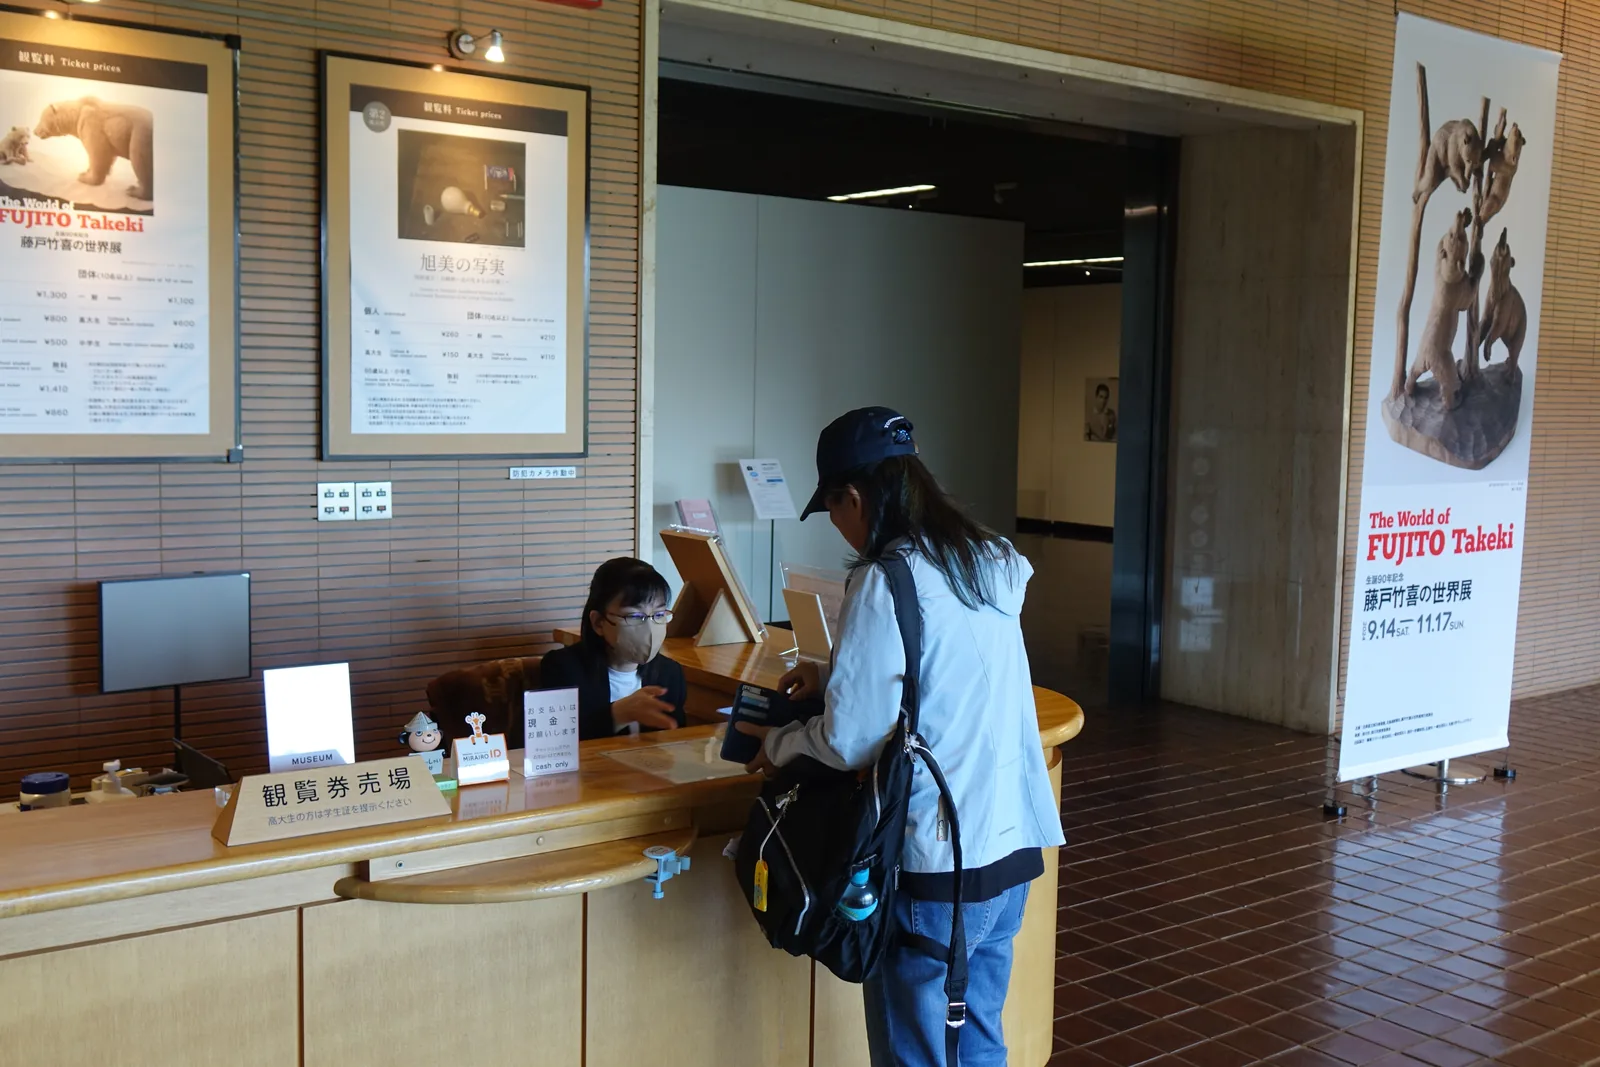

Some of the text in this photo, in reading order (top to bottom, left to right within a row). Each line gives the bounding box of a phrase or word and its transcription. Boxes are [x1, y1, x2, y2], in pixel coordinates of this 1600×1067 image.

[18, 50, 121, 73] 観覧料 Ticket prices
[456, 107, 478, 117] Ticket
[480, 111, 502, 120] prices
[23, 197, 60, 210] World
[62, 200, 75, 211] of
[0, 208, 144, 232] FUJITO Takeki
[20, 235, 122, 254] 藤戸竹喜の世界展
[420, 254, 505, 276] 旭美の写実
[512, 469, 575, 477] 防犯カメラ作動中
[1370, 507, 1451, 528] The World of
[1367, 523, 1514, 566] FUJITO Takeki
[1365, 572, 1404, 585] 生誕90年記念
[1363, 579, 1473, 612] 藤戸竹喜の世界展
[1368, 617, 1396, 641] 9.14
[1417, 611, 1452, 634] 11.17
[528, 704, 576, 715] お支払いは
[528, 716, 576, 728] 現金で
[528, 727, 576, 740] お願いします
[291, 753, 333, 766] MUSEUM
[536, 760, 569, 770] cash only
[262, 767, 411, 808] 観覧券売場
[268, 799, 412, 827] 高大生の方は学生証を提示ください
